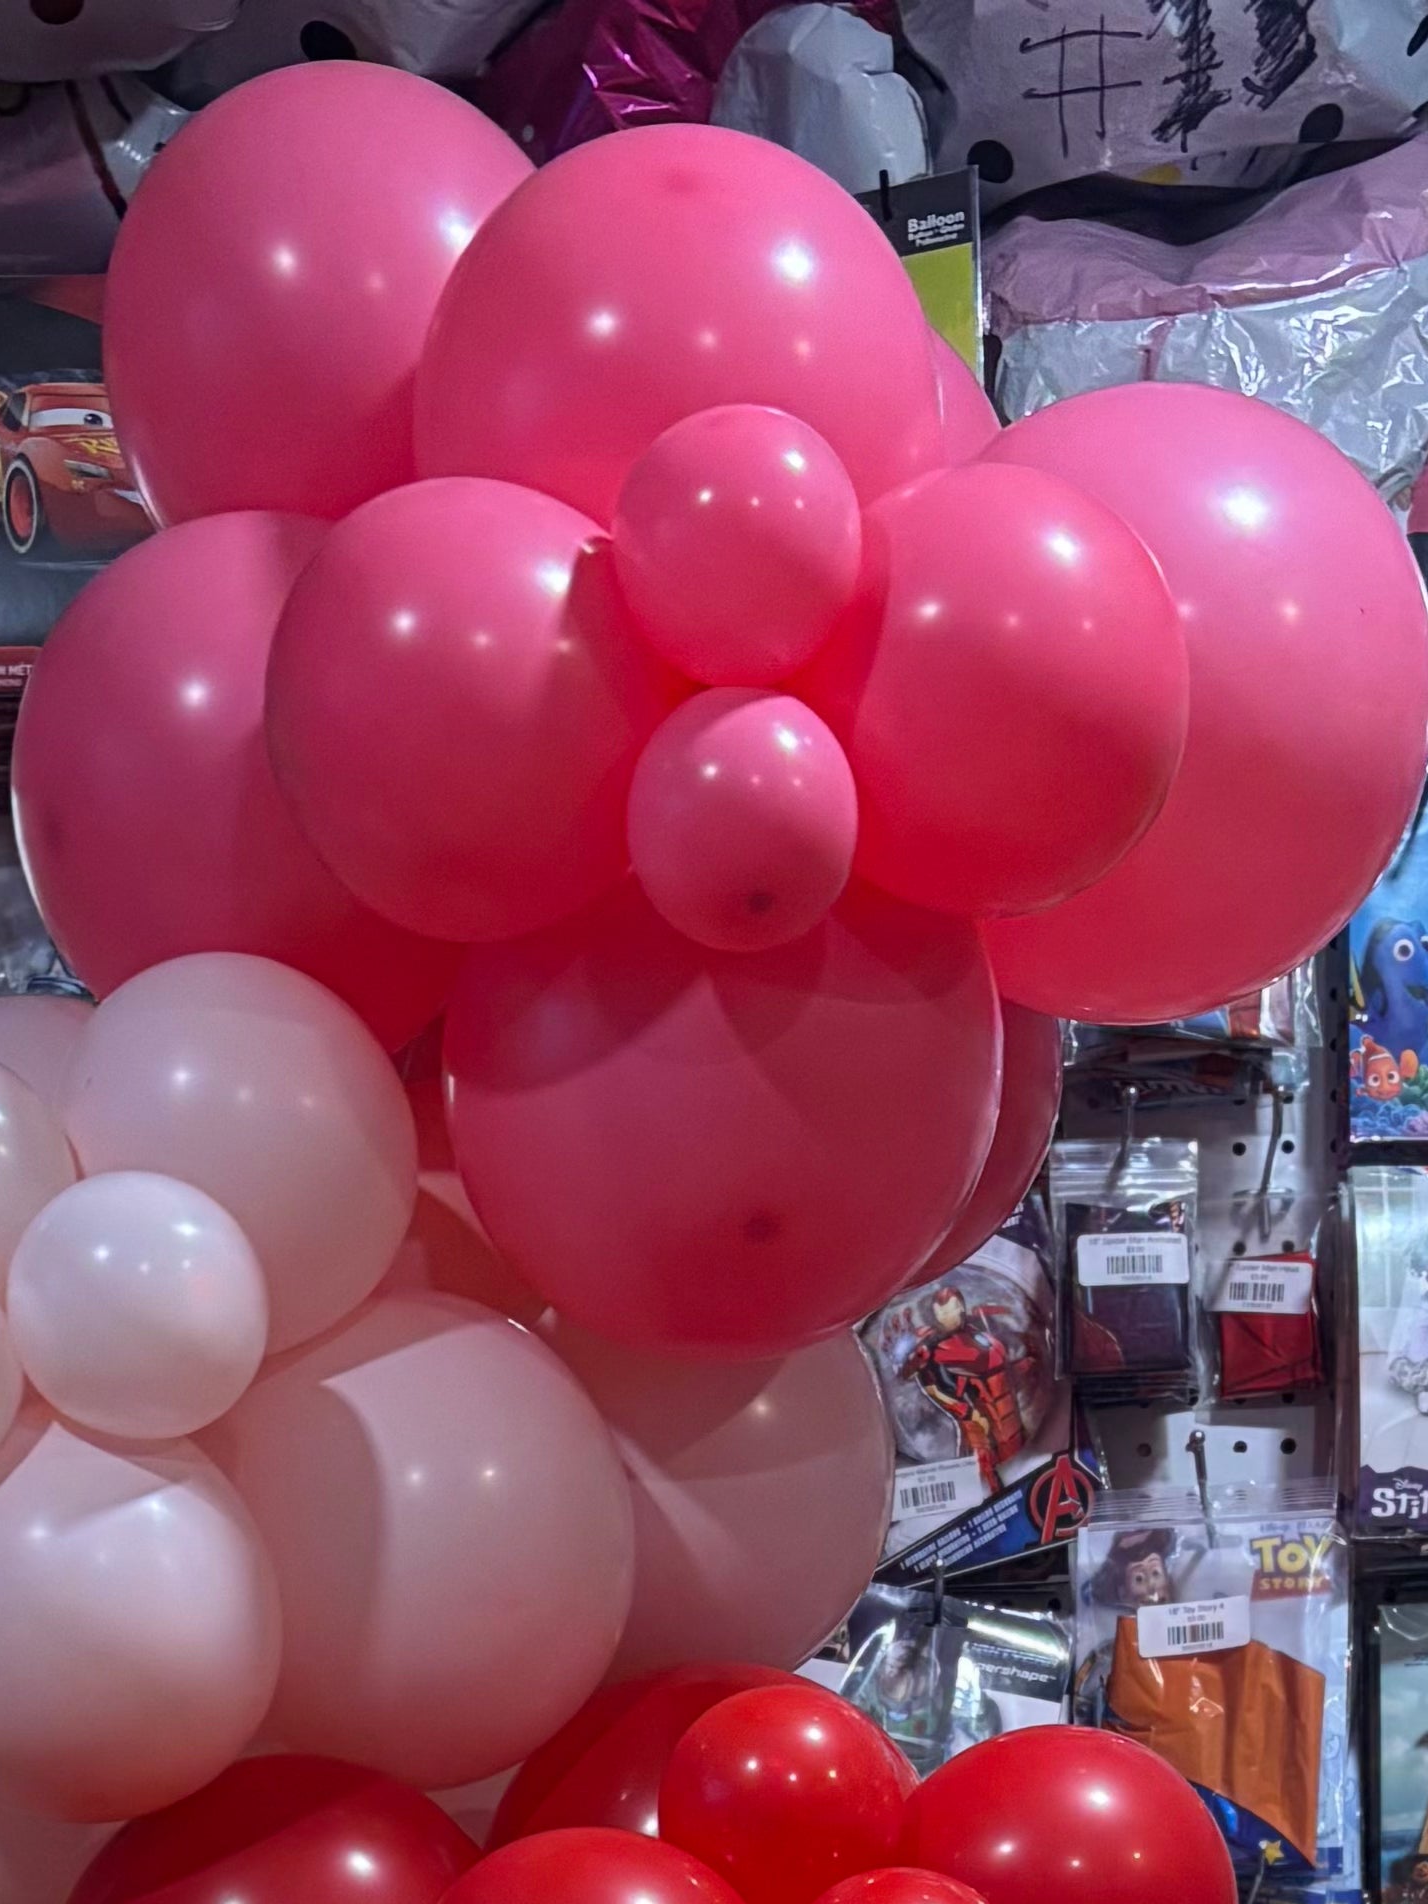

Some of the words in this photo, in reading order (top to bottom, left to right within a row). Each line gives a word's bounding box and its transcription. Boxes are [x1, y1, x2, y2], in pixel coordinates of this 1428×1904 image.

[908, 211, 965, 233] Balloon
[1252, 1532, 1331, 1574] TOY
[1259, 1575, 1324, 1591] STORY
